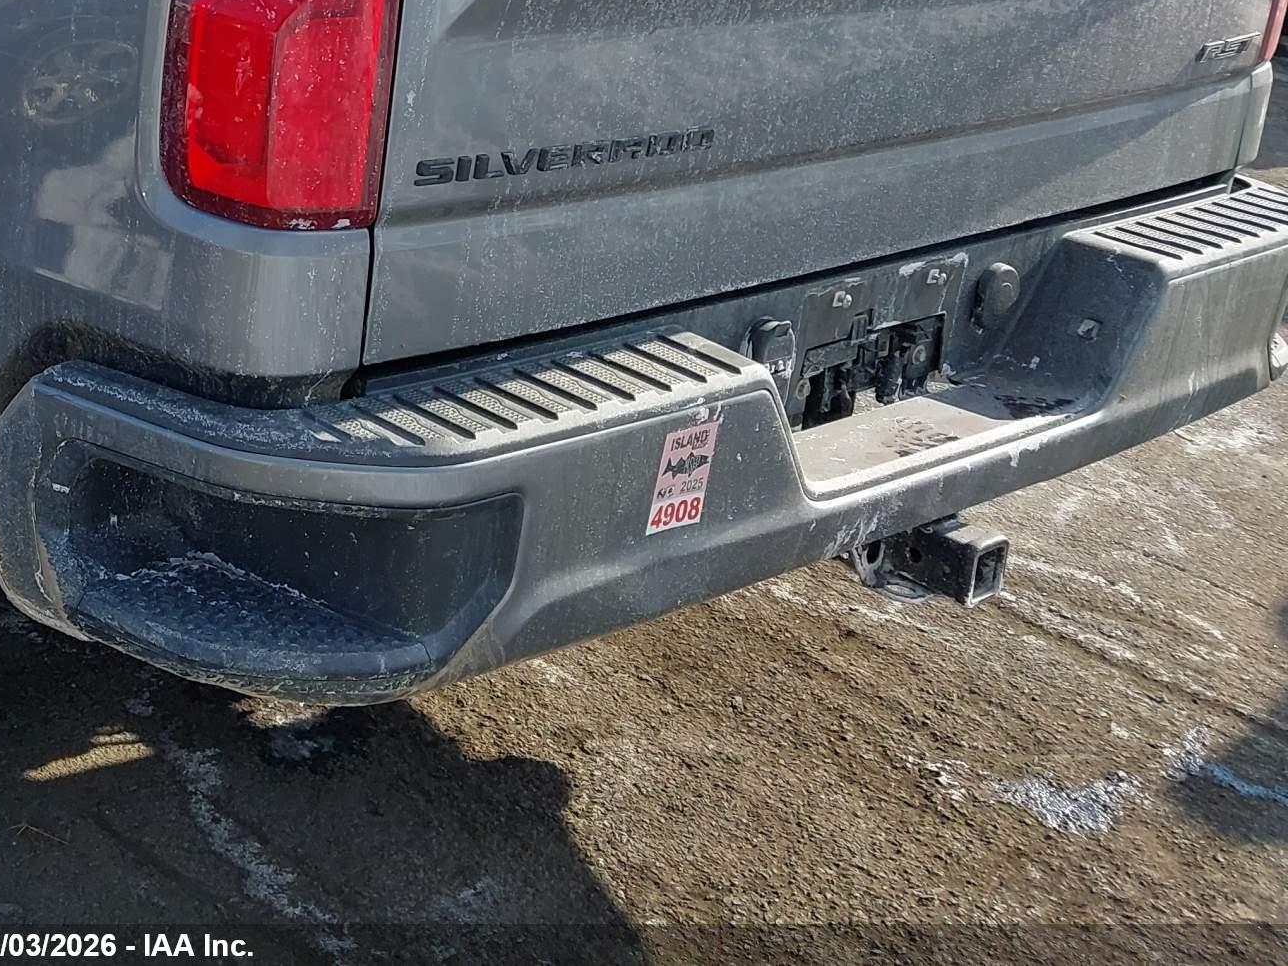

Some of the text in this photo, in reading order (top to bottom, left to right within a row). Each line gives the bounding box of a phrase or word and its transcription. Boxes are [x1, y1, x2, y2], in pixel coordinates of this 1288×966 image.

[414, 126, 715, 186] SILVERADO
[671, 429, 710, 451] ISLAND
[680, 477, 705, 493] 2025
[650, 497, 702, 529] 4908
